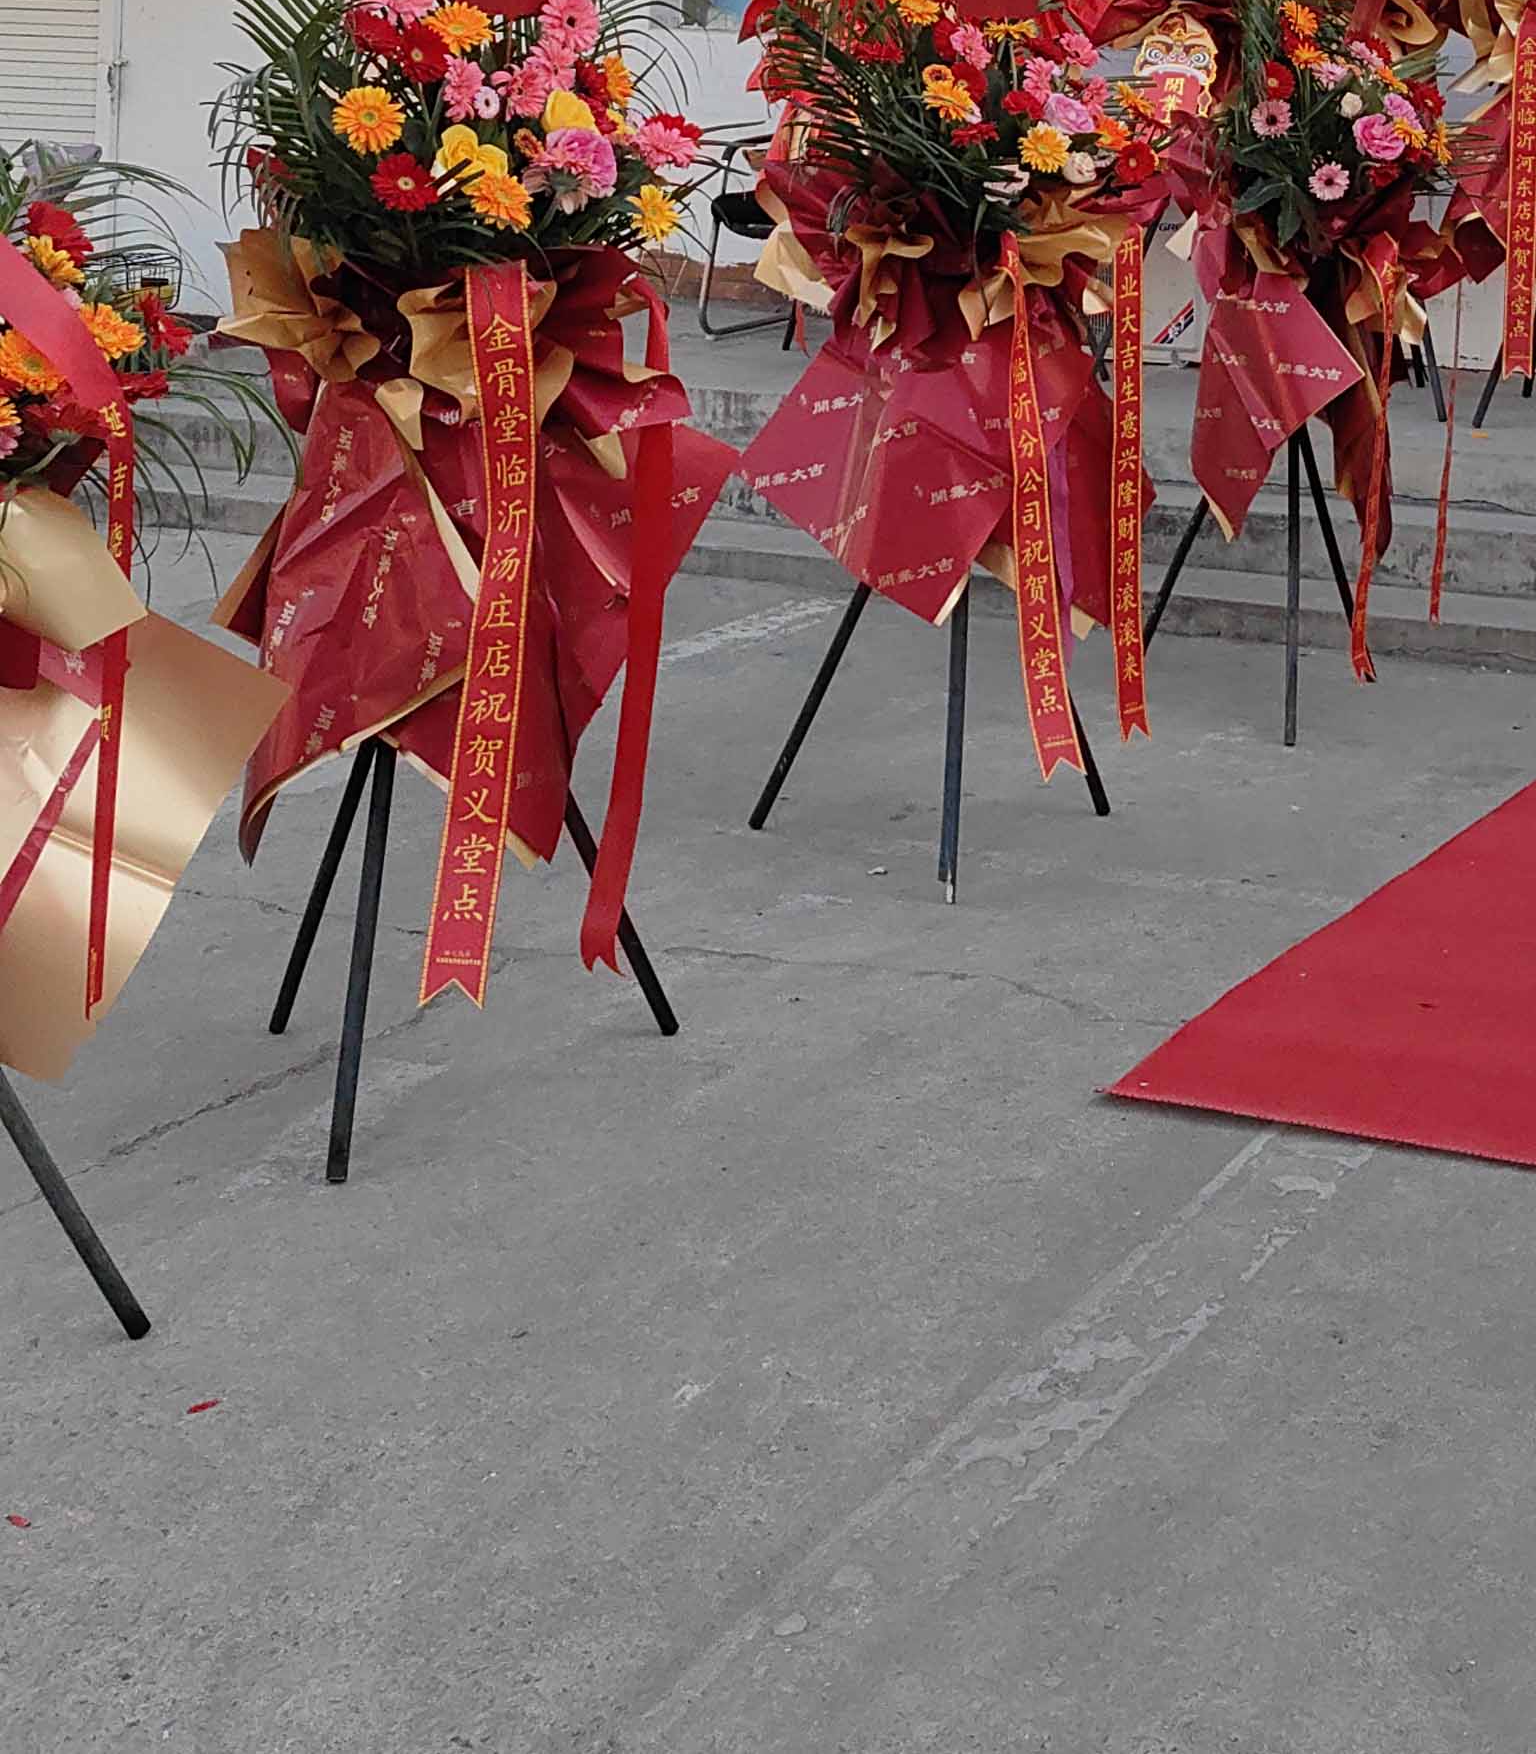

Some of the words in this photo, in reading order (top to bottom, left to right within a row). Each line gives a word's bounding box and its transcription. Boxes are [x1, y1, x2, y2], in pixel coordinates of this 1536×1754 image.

[443, 312, 529, 923] 金骨堂临沂汤庄店祝贺义堂点
[1116, 238, 1140, 681] 开业大吉生意兴隆财源滚滚来
